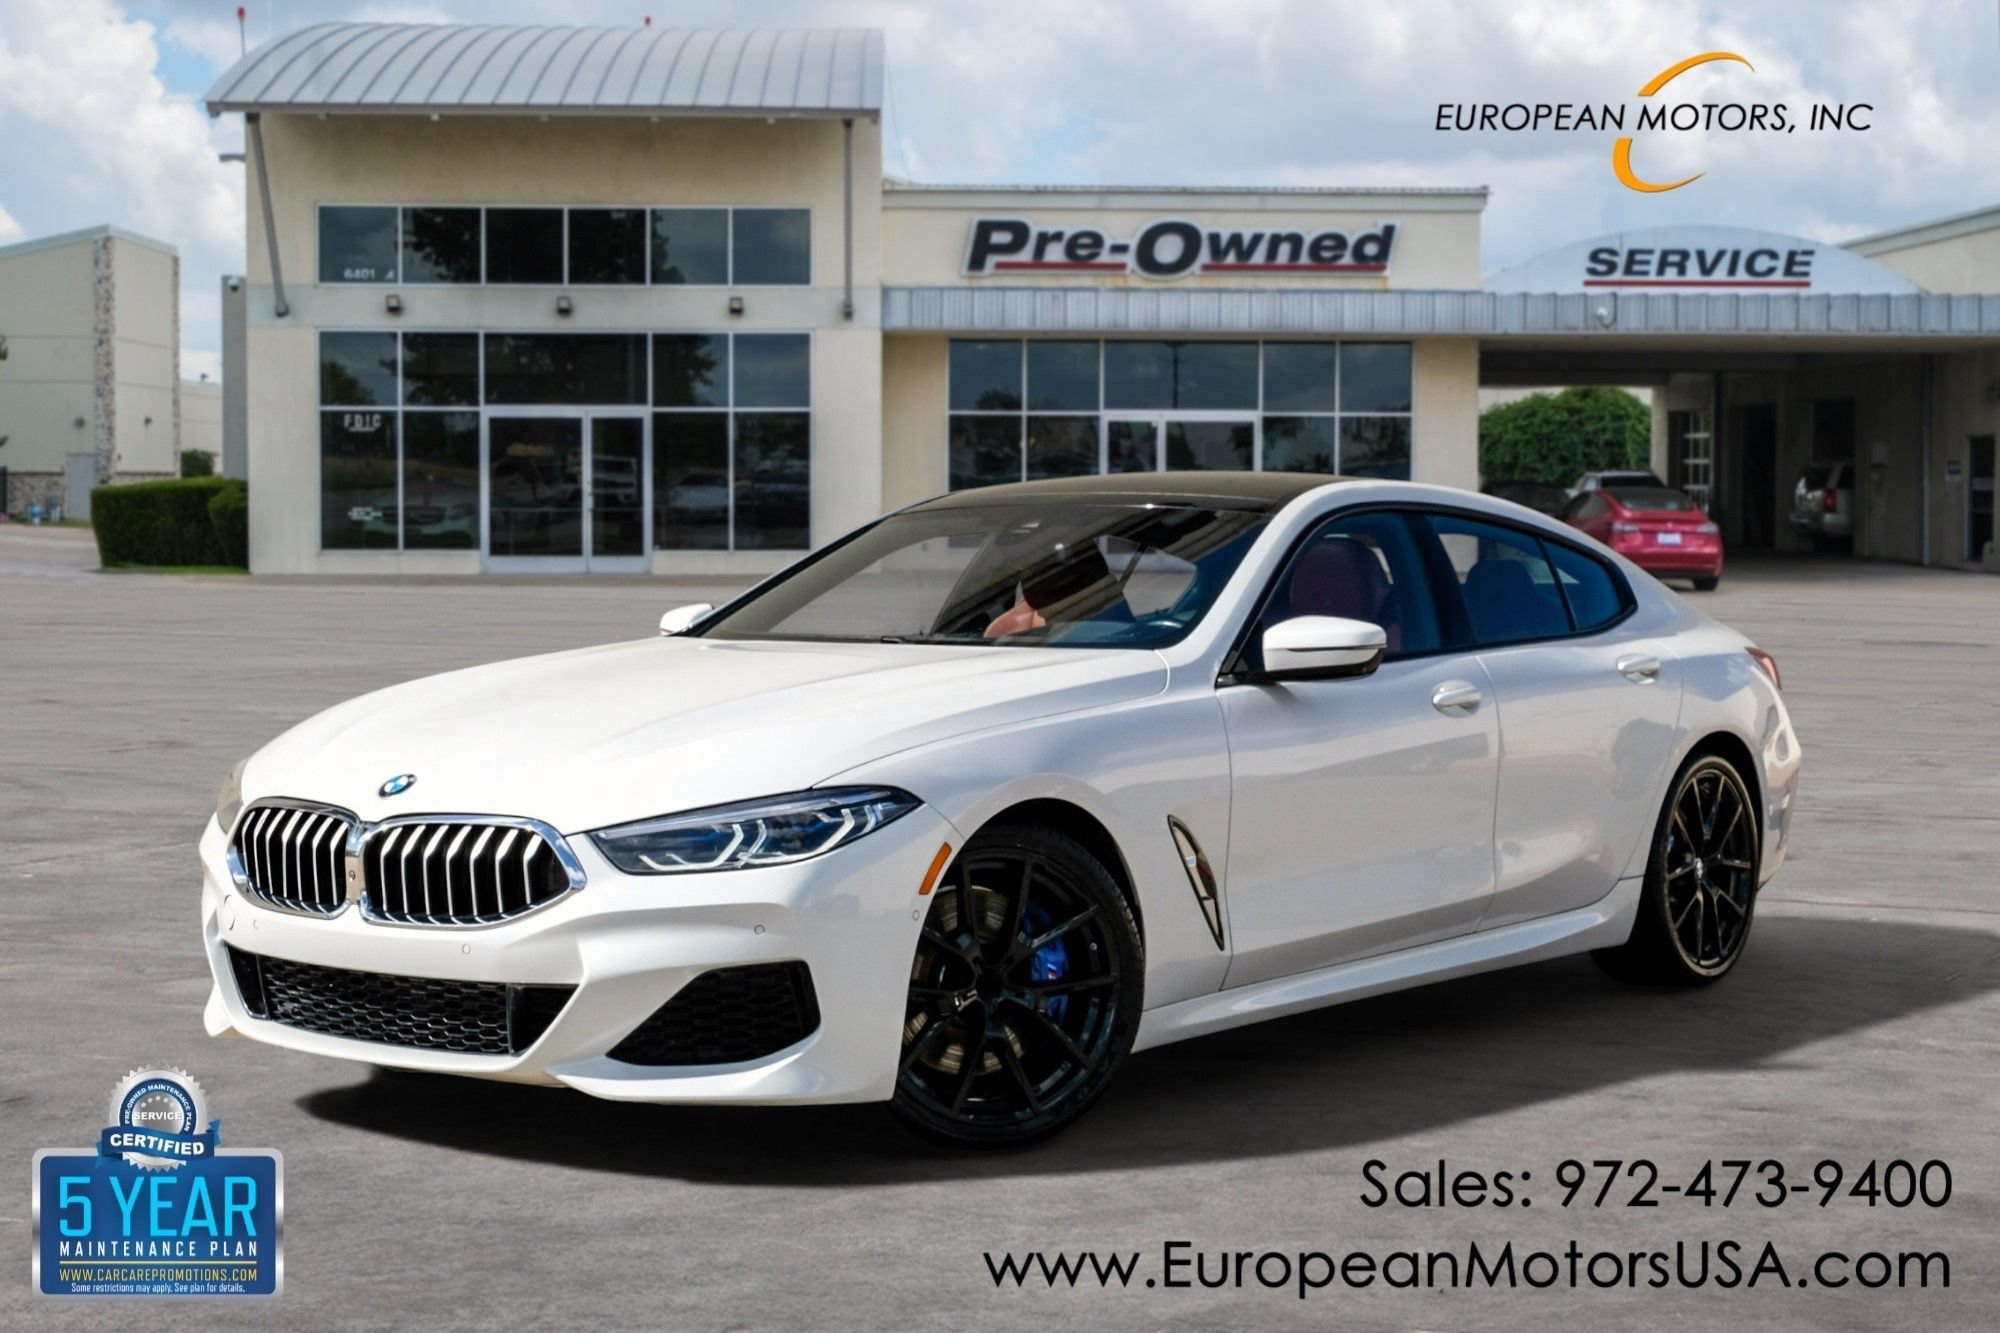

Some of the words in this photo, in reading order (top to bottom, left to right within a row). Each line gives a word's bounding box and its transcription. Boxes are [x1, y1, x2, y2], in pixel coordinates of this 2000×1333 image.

[967, 219, 1396, 276] Pre-Owned
[343, 267, 376, 281] 6401
[1587, 248, 1815, 278] SERVICE
